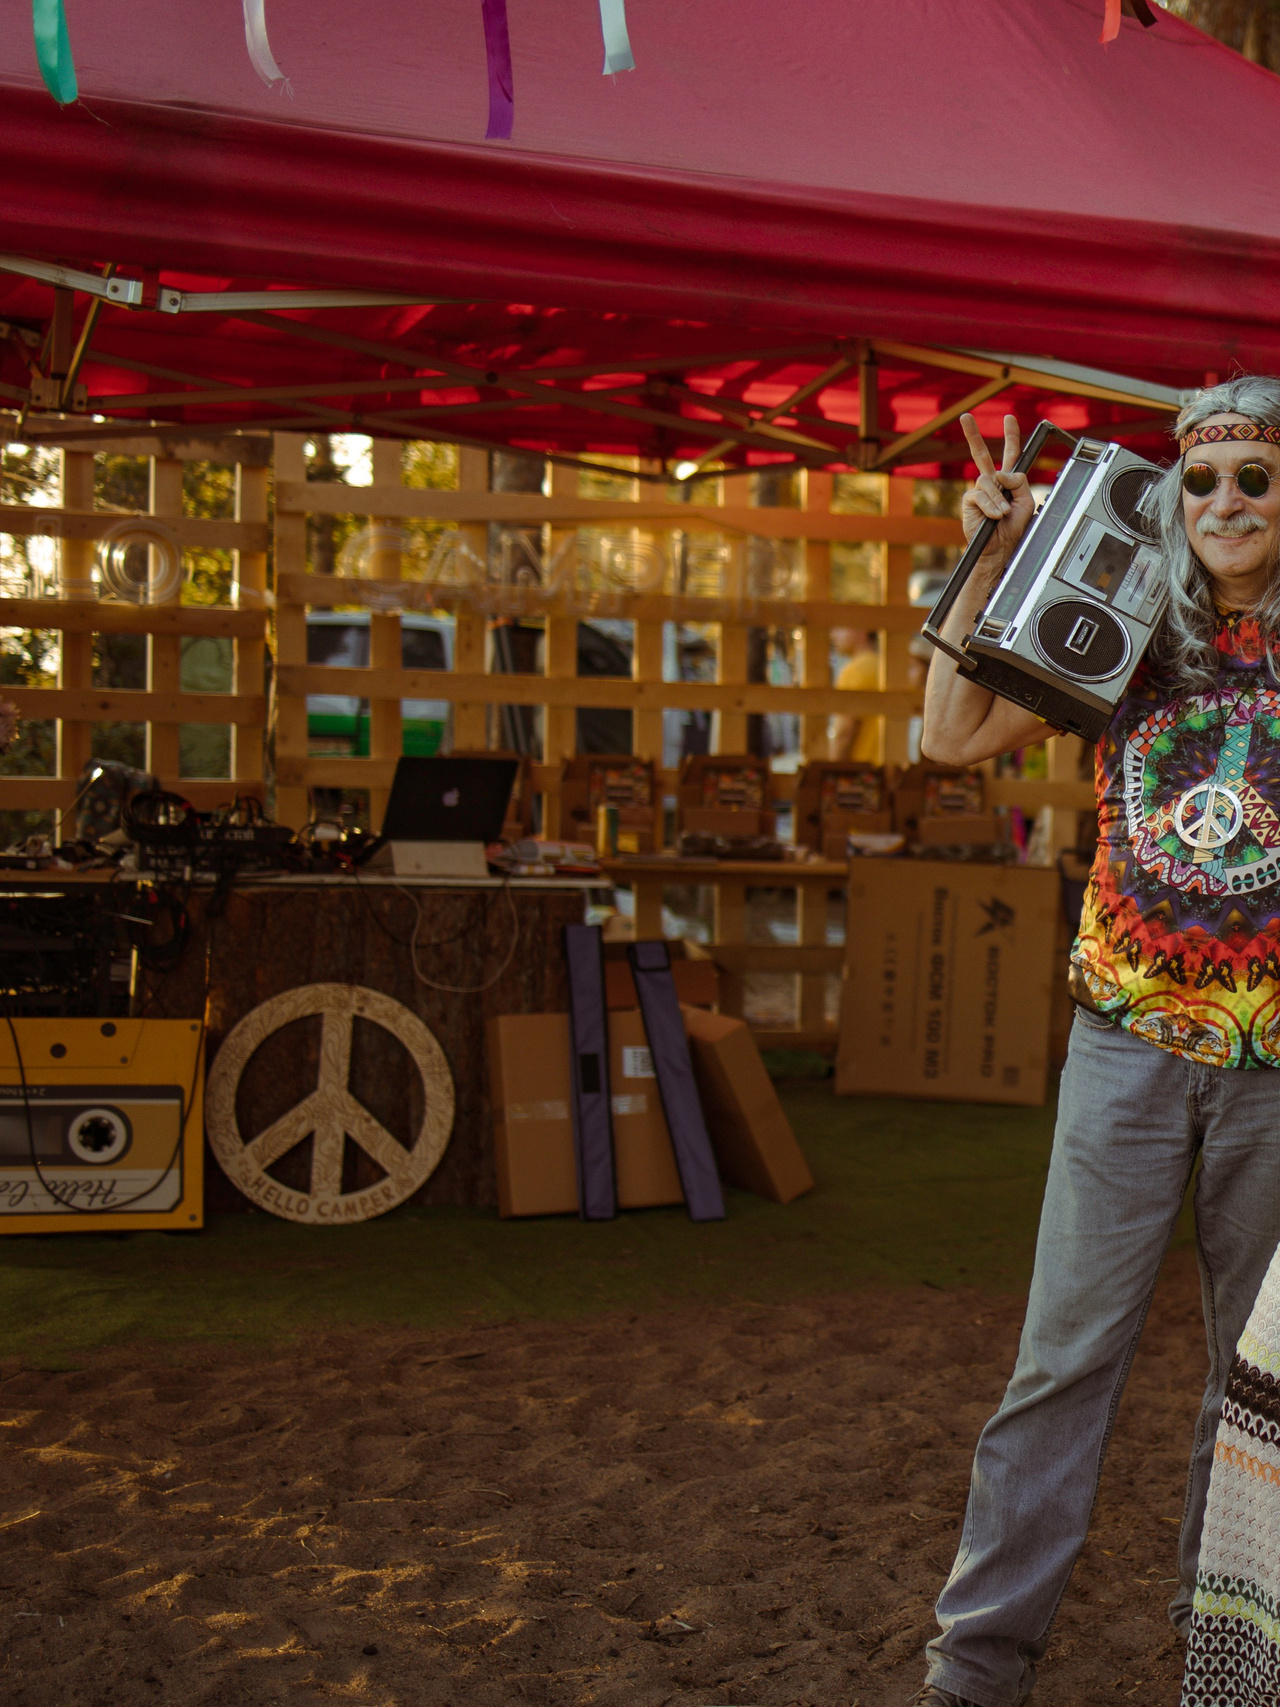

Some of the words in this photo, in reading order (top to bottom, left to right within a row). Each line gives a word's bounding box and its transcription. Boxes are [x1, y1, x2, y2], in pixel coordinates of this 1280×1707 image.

[926, 1008, 942, 1044] 100
[46, 1179, 118, 1209] Hello
[252, 1176, 310, 1216] HELLO
[316, 1184, 398, 1218] CAMPER
